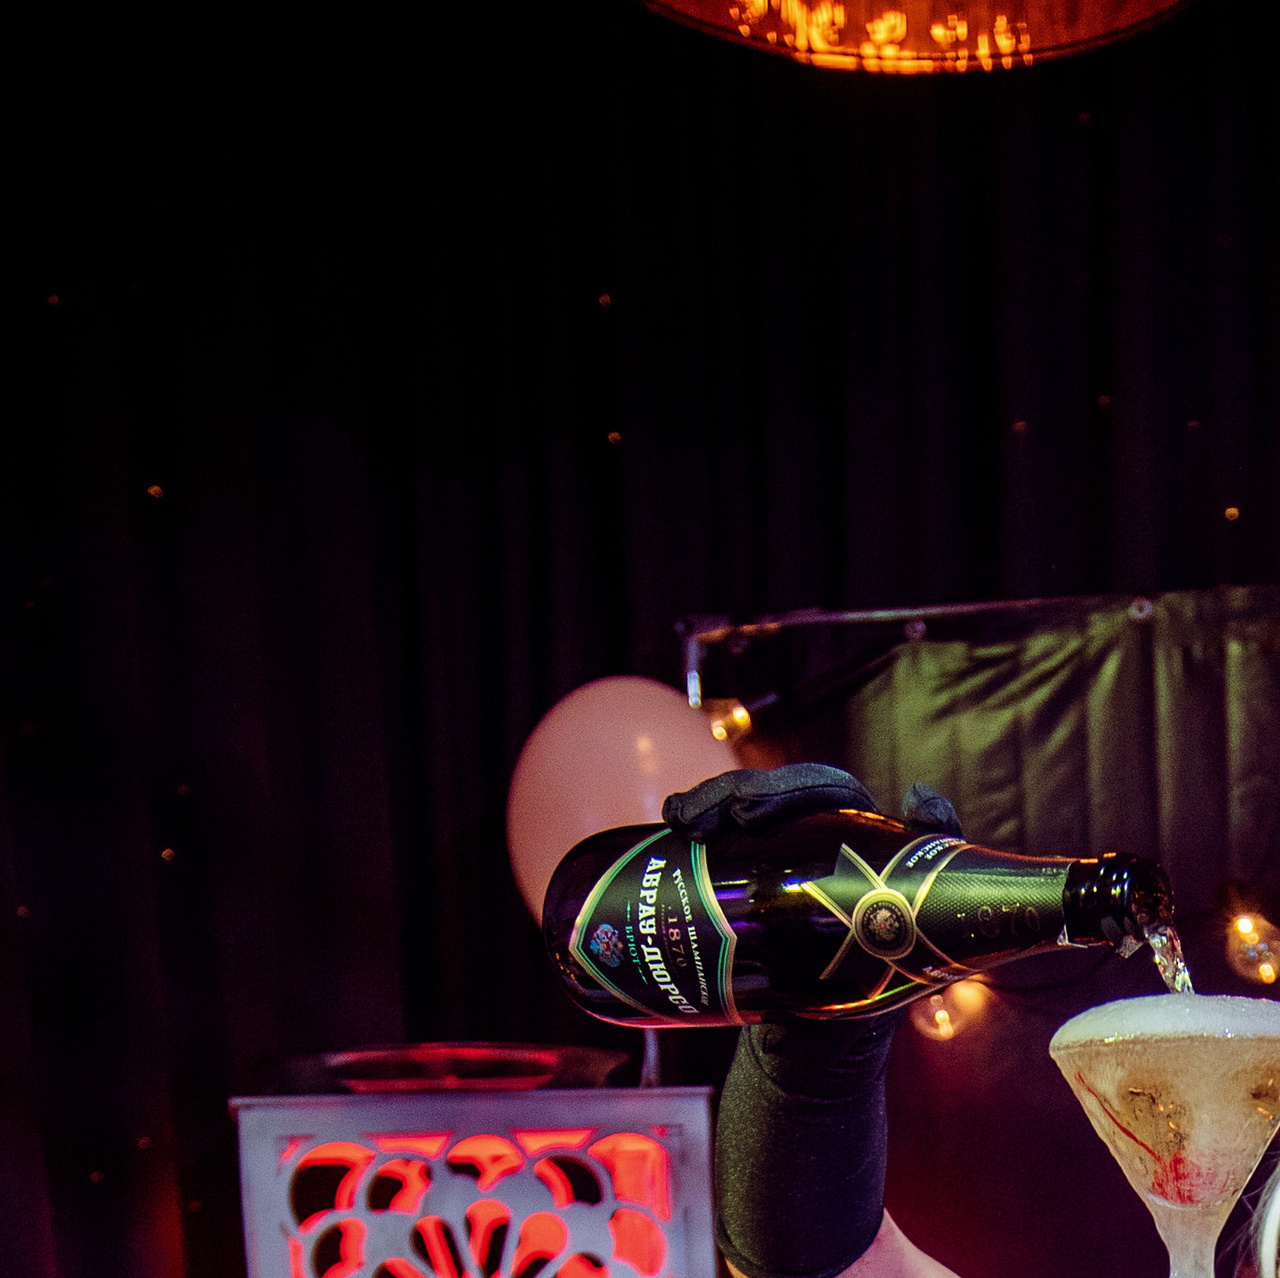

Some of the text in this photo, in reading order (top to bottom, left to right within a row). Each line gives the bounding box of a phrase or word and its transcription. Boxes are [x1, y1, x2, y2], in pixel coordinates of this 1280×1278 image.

[671, 866, 692, 923] РУССКОЕ
[624, 925, 642, 965] БРЮТ
[638, 856, 700, 1014] АБРАУ-ДЮРСО
[667, 915, 687, 968] 1870
